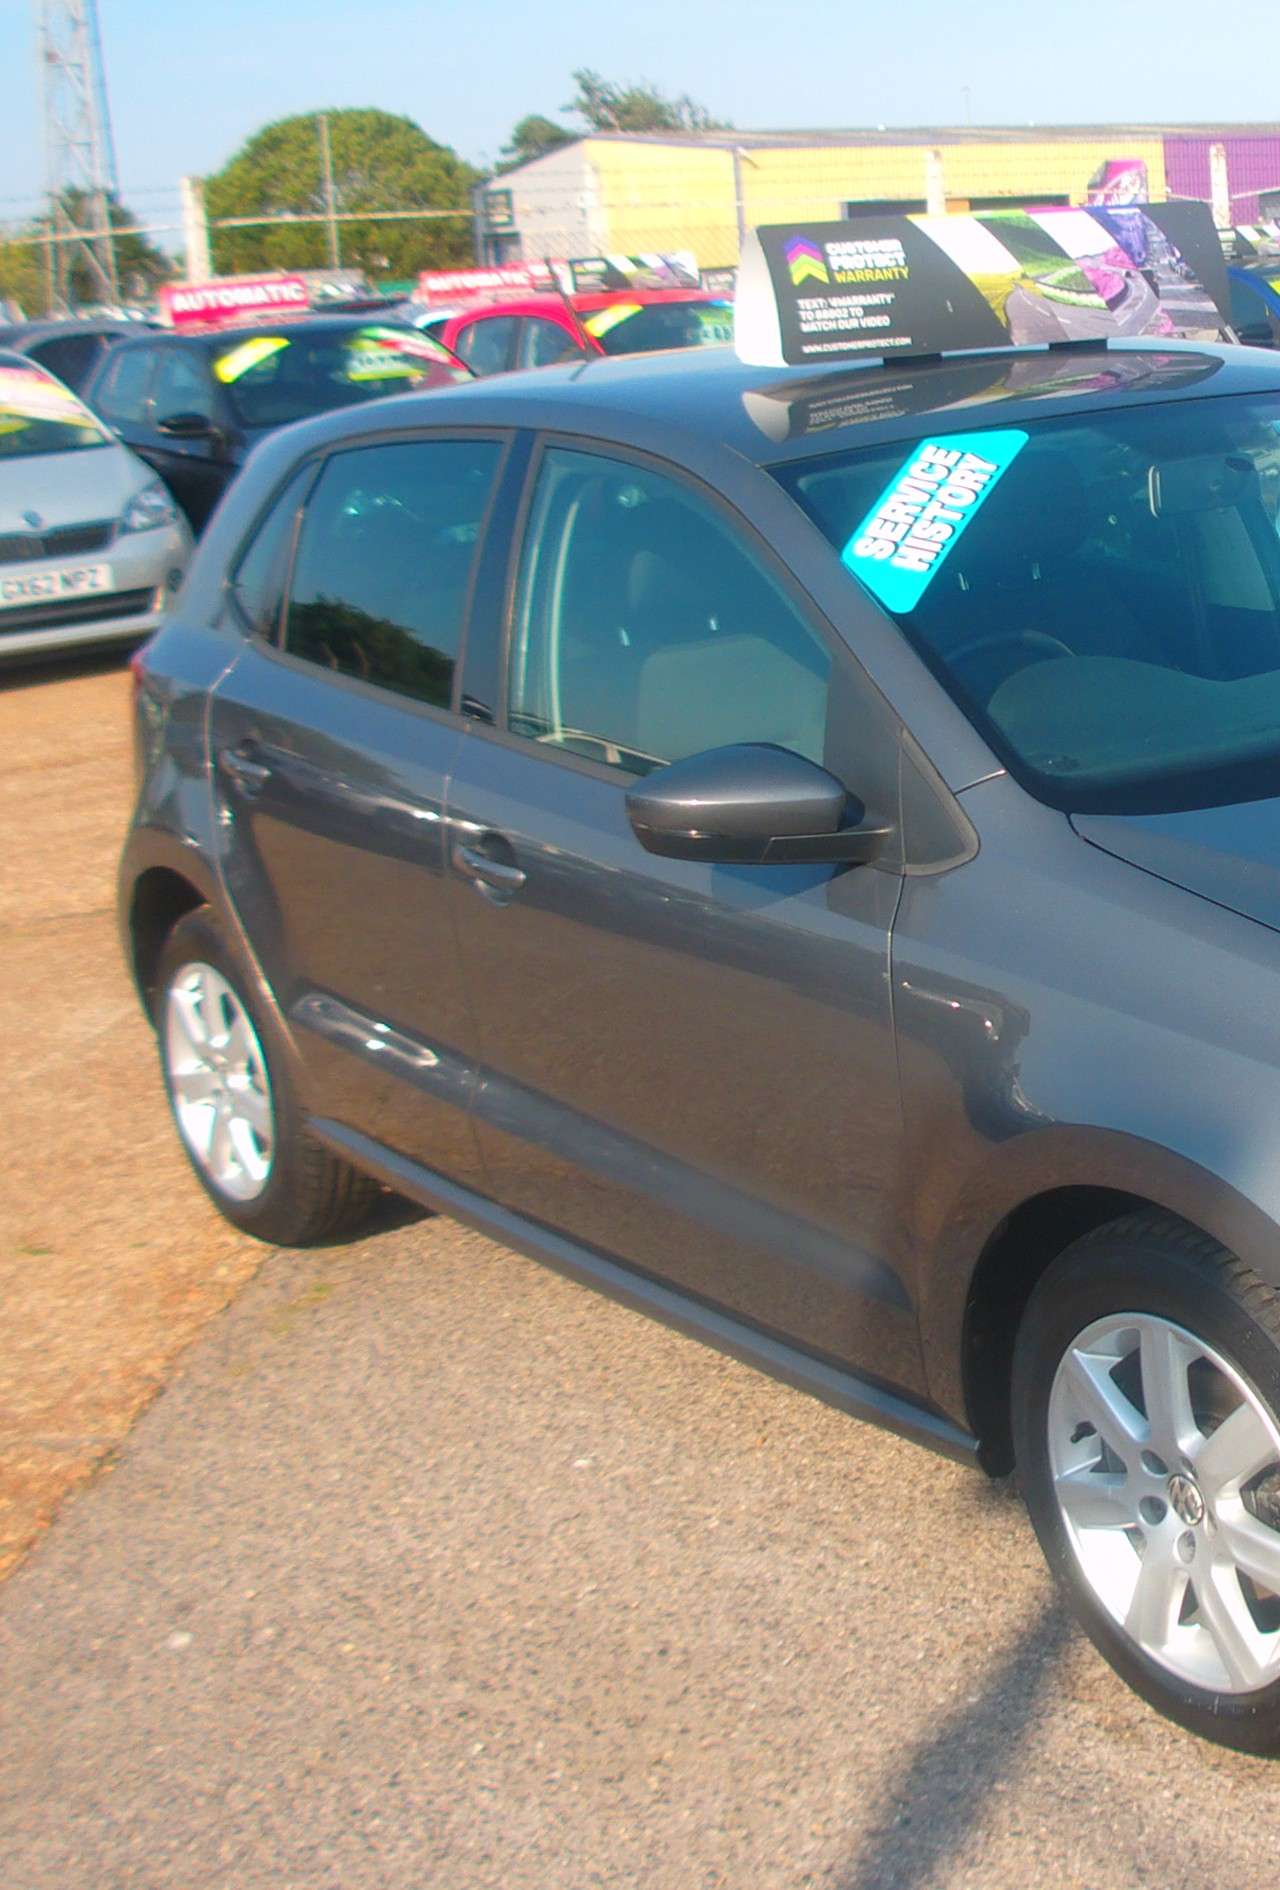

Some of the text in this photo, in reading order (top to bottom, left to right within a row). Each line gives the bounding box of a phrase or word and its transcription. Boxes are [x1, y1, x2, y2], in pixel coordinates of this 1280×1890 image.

[828, 252, 907, 271] PROTECT
[834, 266, 909, 284] WARRANTY
[173, 281, 306, 312] AUTOMATIC
[854, 444, 962, 560] SERVICE
[891, 452, 999, 573] HISTORY
